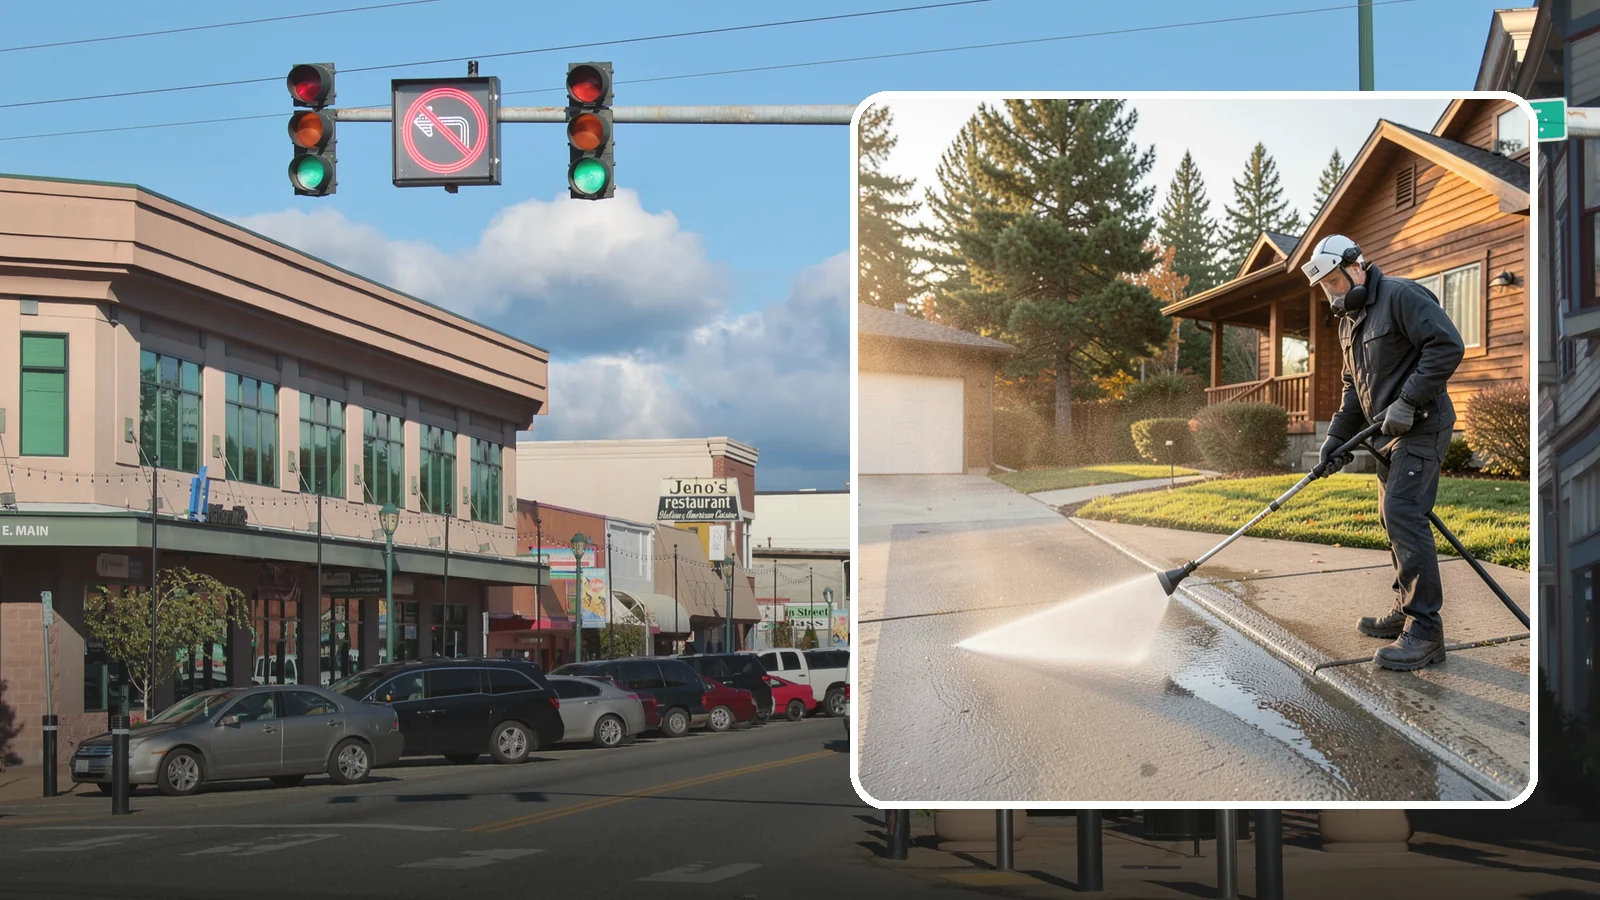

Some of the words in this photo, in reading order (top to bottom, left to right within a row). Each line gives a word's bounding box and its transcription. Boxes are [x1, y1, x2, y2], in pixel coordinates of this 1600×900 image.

[670, 480, 727, 494] Jeno's
[665, 496, 731, 509] restaurant
[658, 509, 681, 519] Italian
[686, 509, 714, 519] American
[715, 509, 737, 519] Cuisine
[2, 525, 13, 536] E.
[15, 525, 49, 536] MAIN
[797, 607, 828, 616] Street
[791, 619, 824, 627] lass
